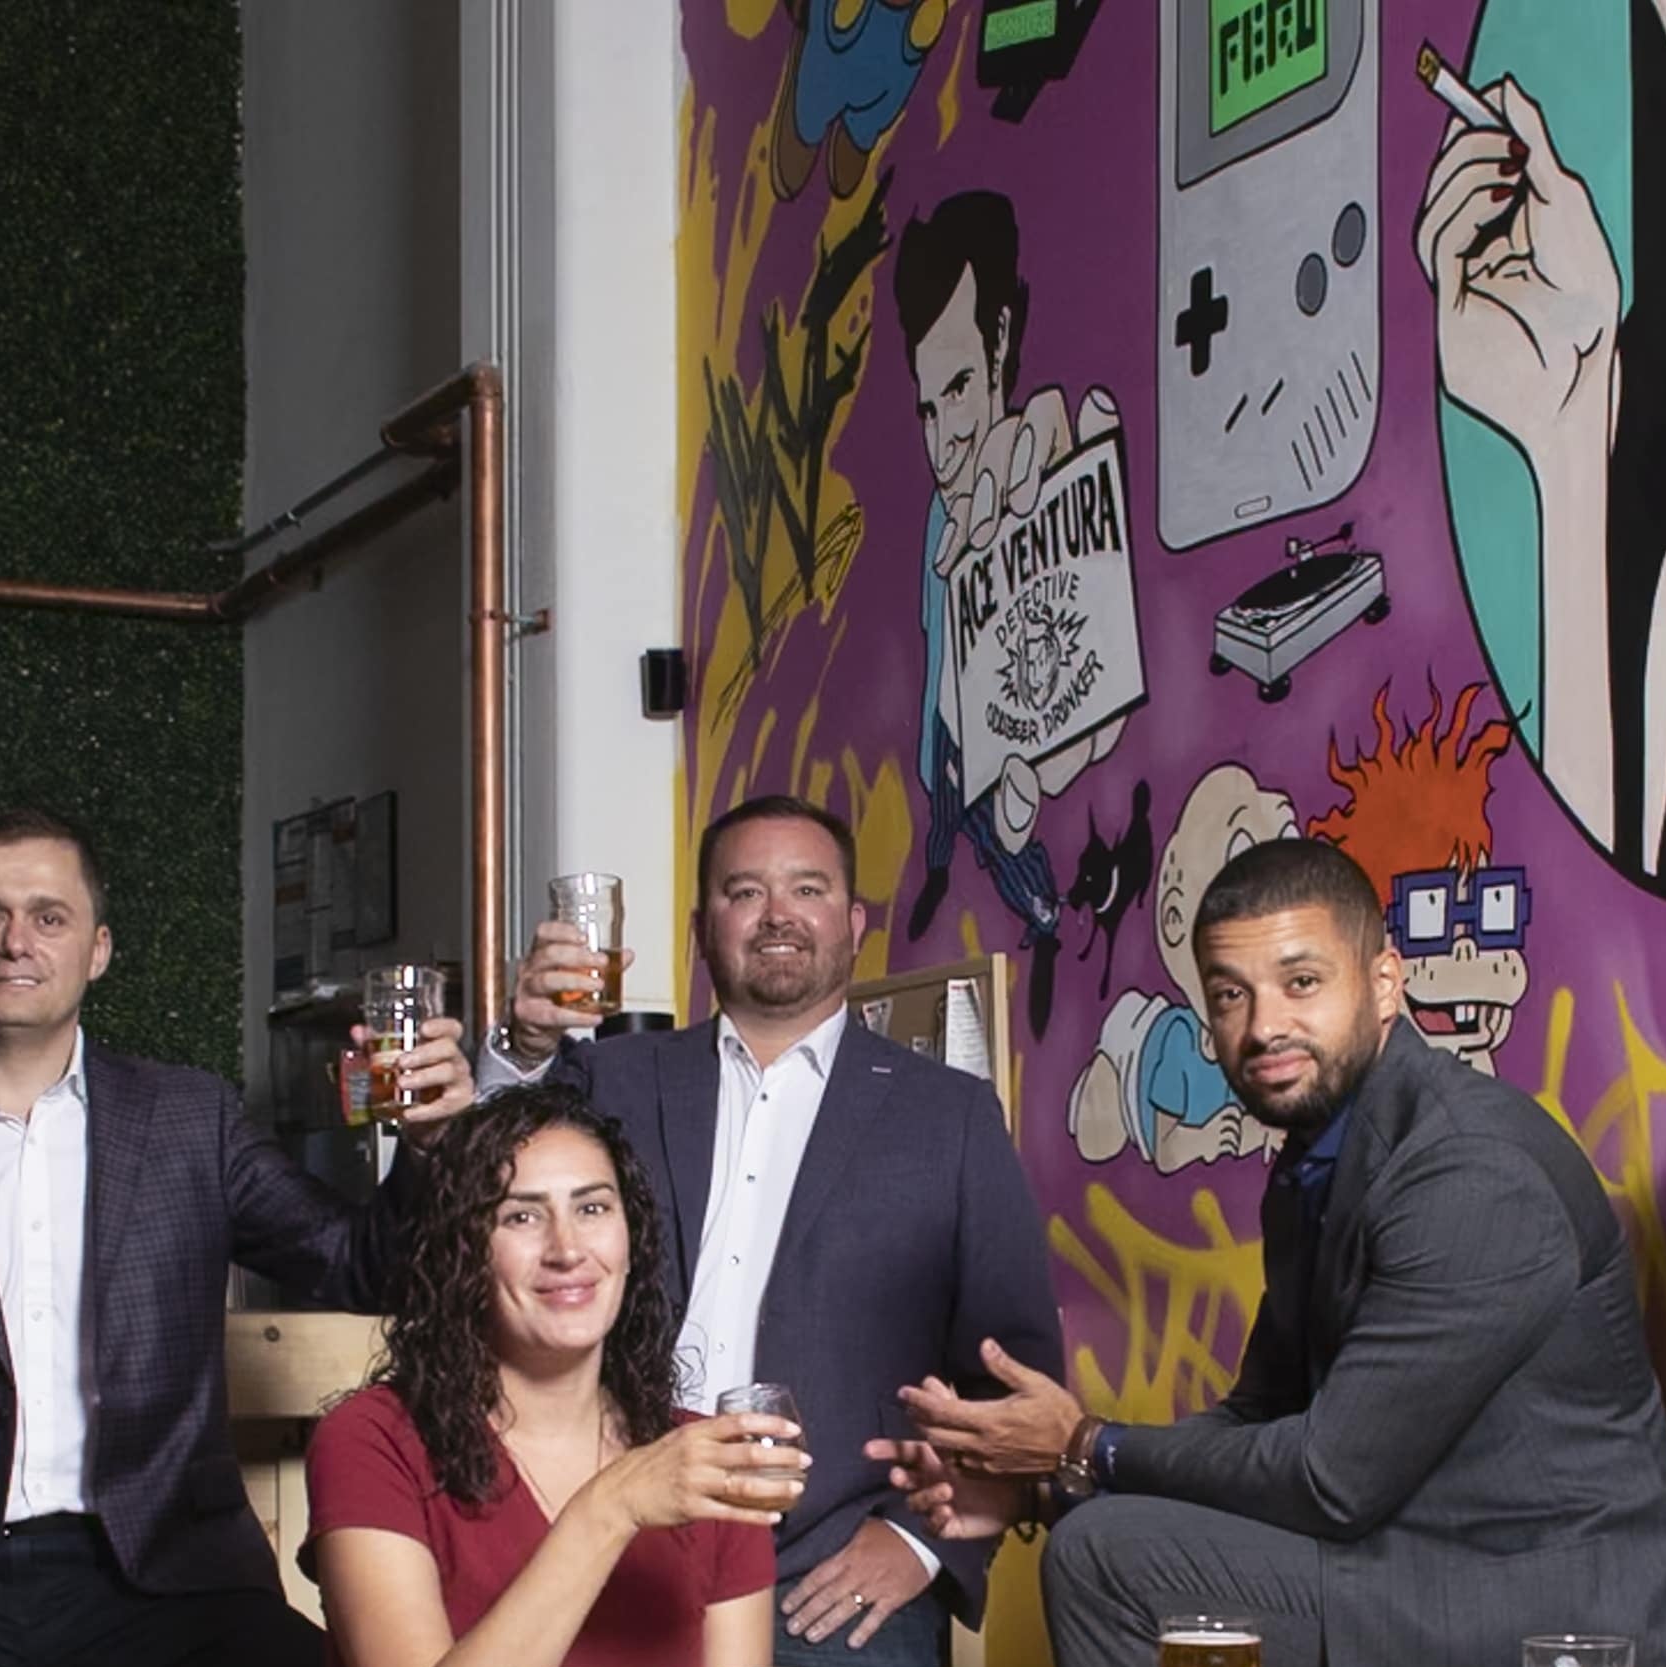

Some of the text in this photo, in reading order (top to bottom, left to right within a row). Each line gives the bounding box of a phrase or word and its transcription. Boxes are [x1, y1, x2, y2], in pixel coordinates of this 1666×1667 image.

[959, 459, 1123, 674] ACE VENTURA
[995, 573, 1081, 649] DETECTIVE
